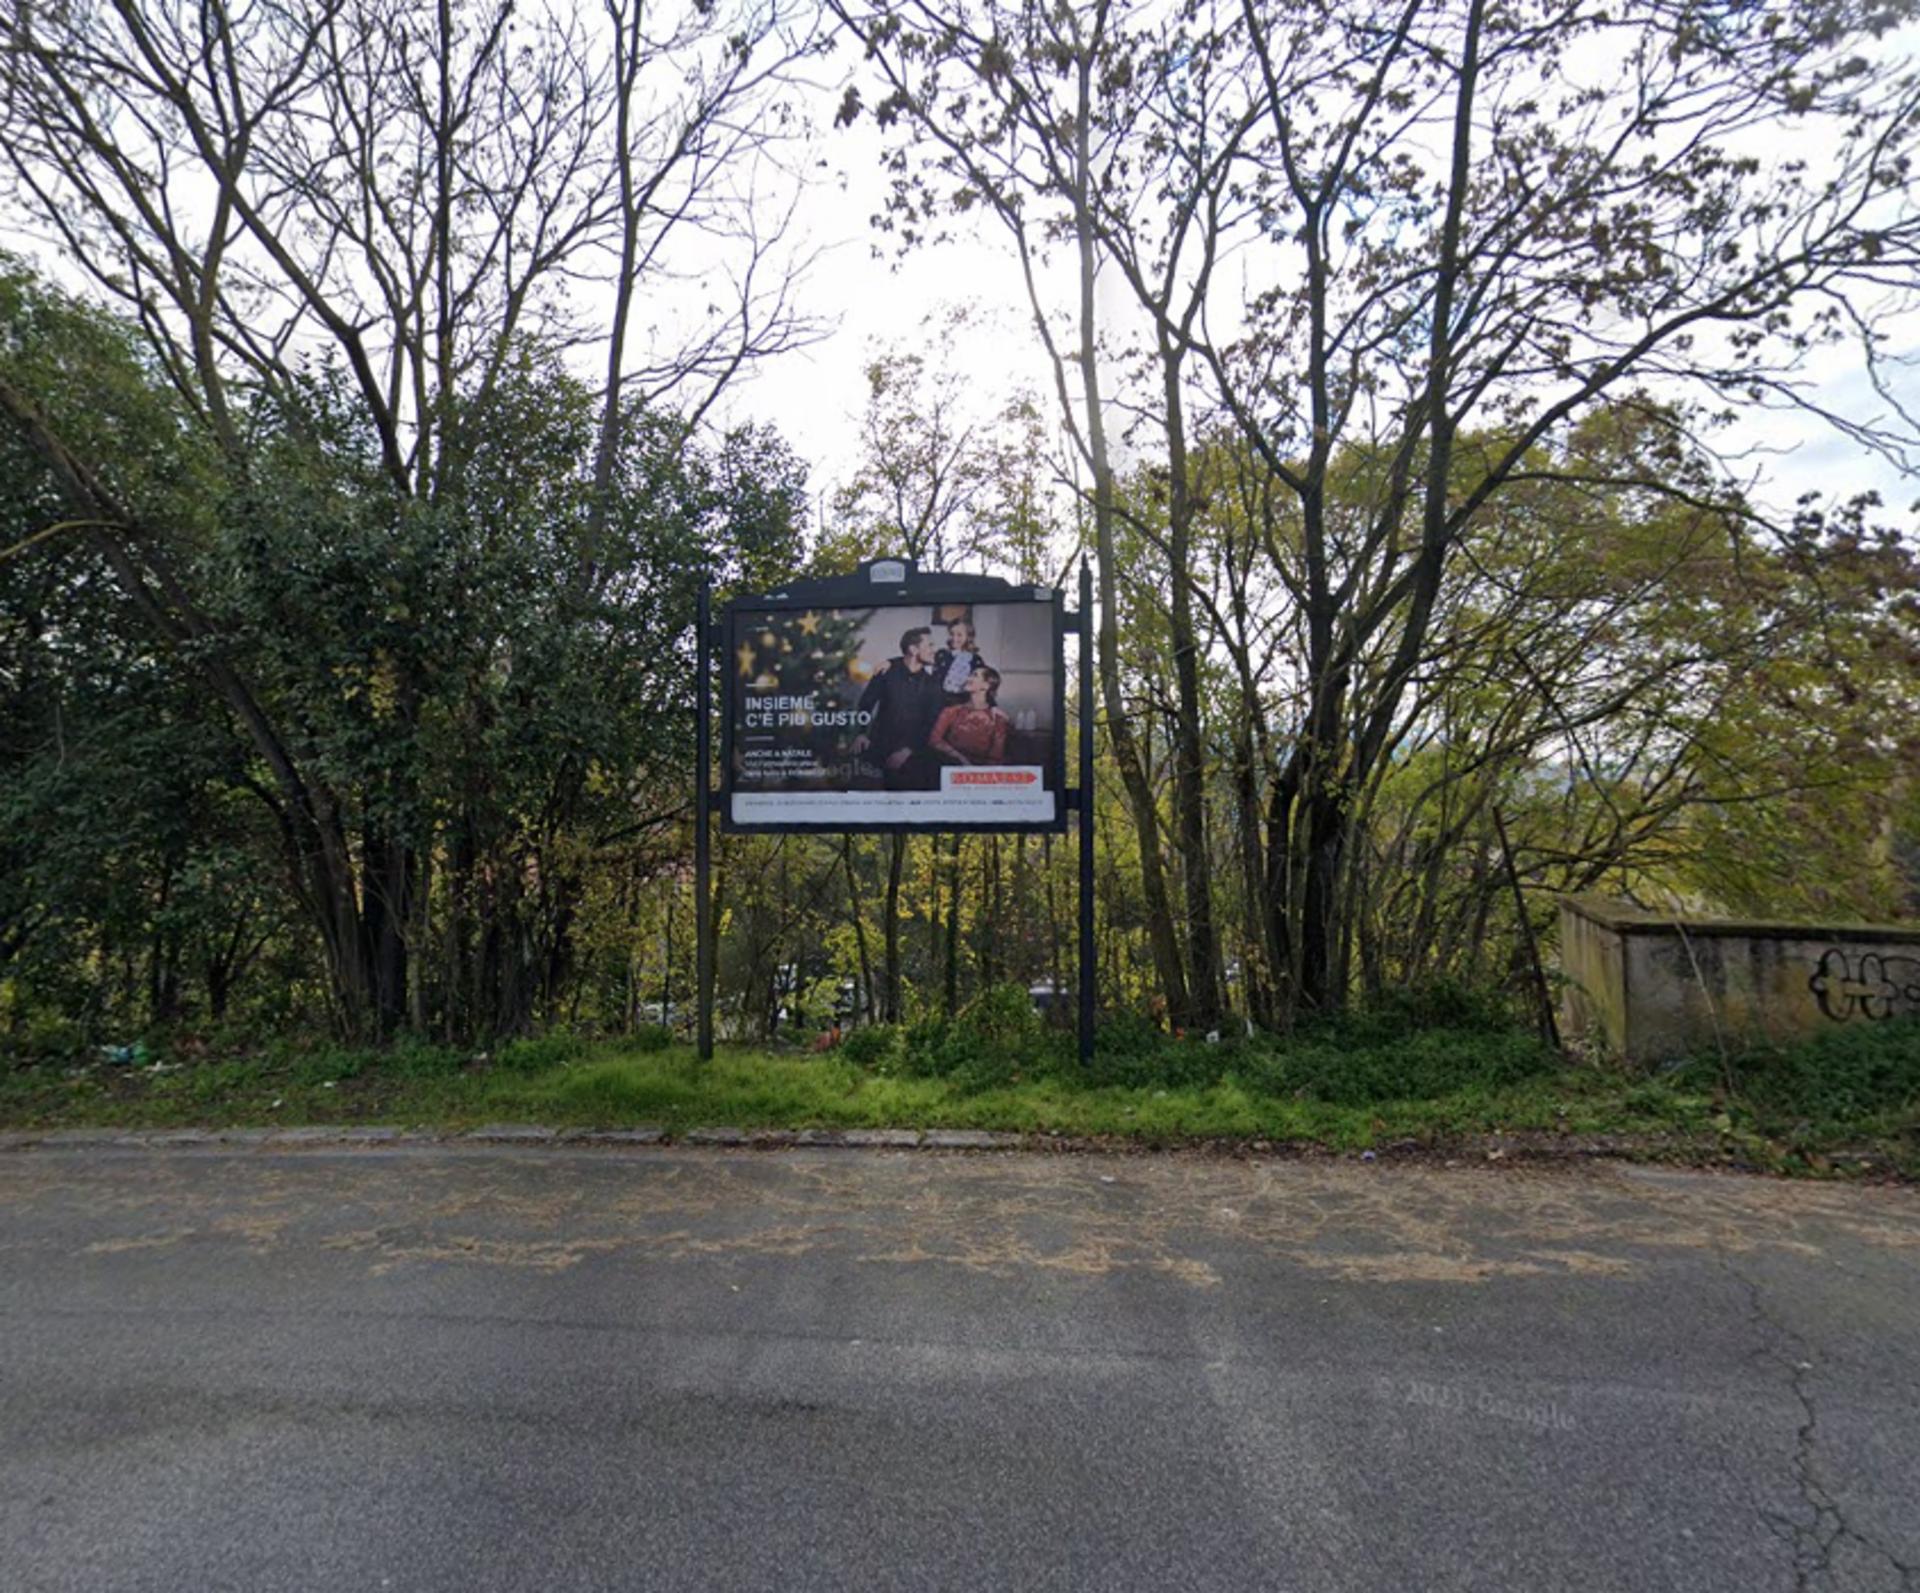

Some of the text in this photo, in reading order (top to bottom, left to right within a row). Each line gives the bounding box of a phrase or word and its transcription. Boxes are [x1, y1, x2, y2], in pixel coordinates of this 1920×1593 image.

[744, 695, 814, 711] INSIEME
[744, 709, 774, 727] C'È
[810, 710, 872, 727] GUSTO
